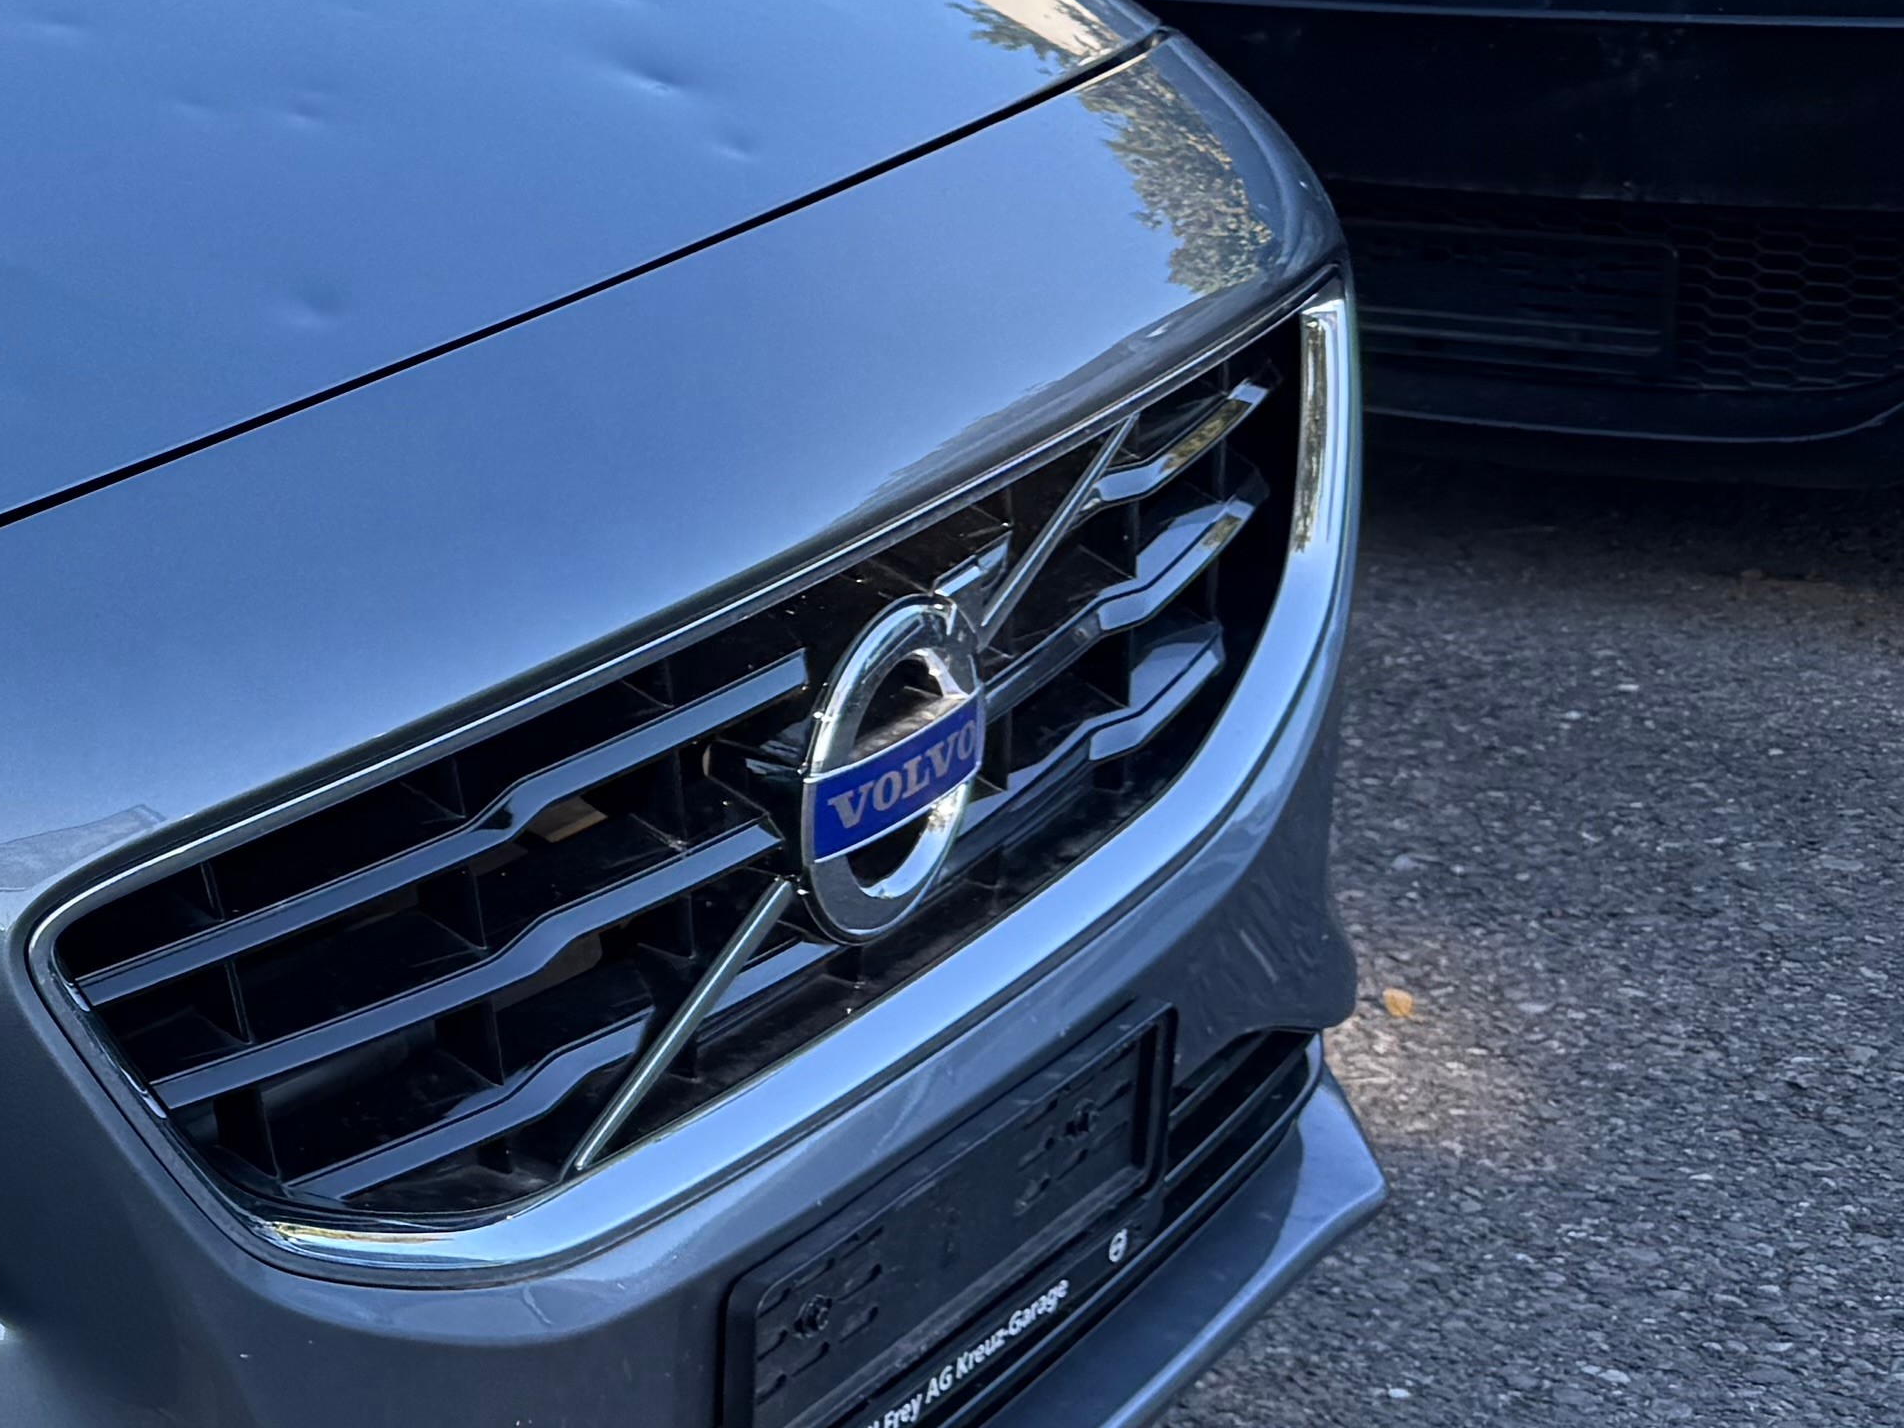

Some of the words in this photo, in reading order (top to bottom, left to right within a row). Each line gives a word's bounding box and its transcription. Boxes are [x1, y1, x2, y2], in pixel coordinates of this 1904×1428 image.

[827, 718, 976, 830] VOLVO
[925, 1365, 953, 1404] AG
[955, 1279, 1070, 1380] Kreuz-Garage
